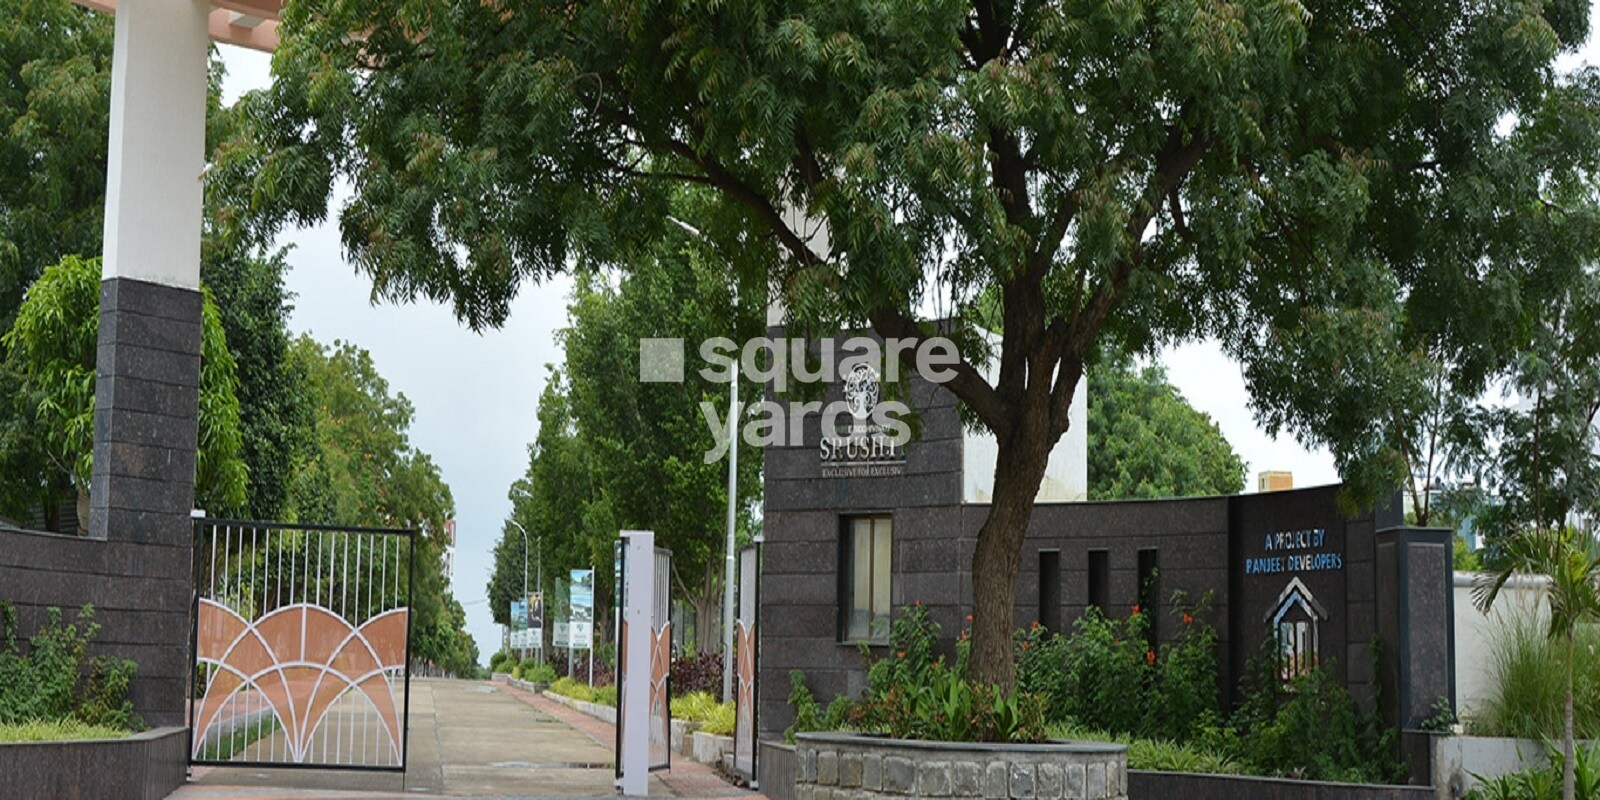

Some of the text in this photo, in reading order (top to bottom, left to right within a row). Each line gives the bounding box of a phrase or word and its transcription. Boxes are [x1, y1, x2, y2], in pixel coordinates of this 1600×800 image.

[1265, 532, 1273, 550] A
[1313, 528, 1325, 547] BY
[1287, 552, 1343, 571] DEVELOPERS
